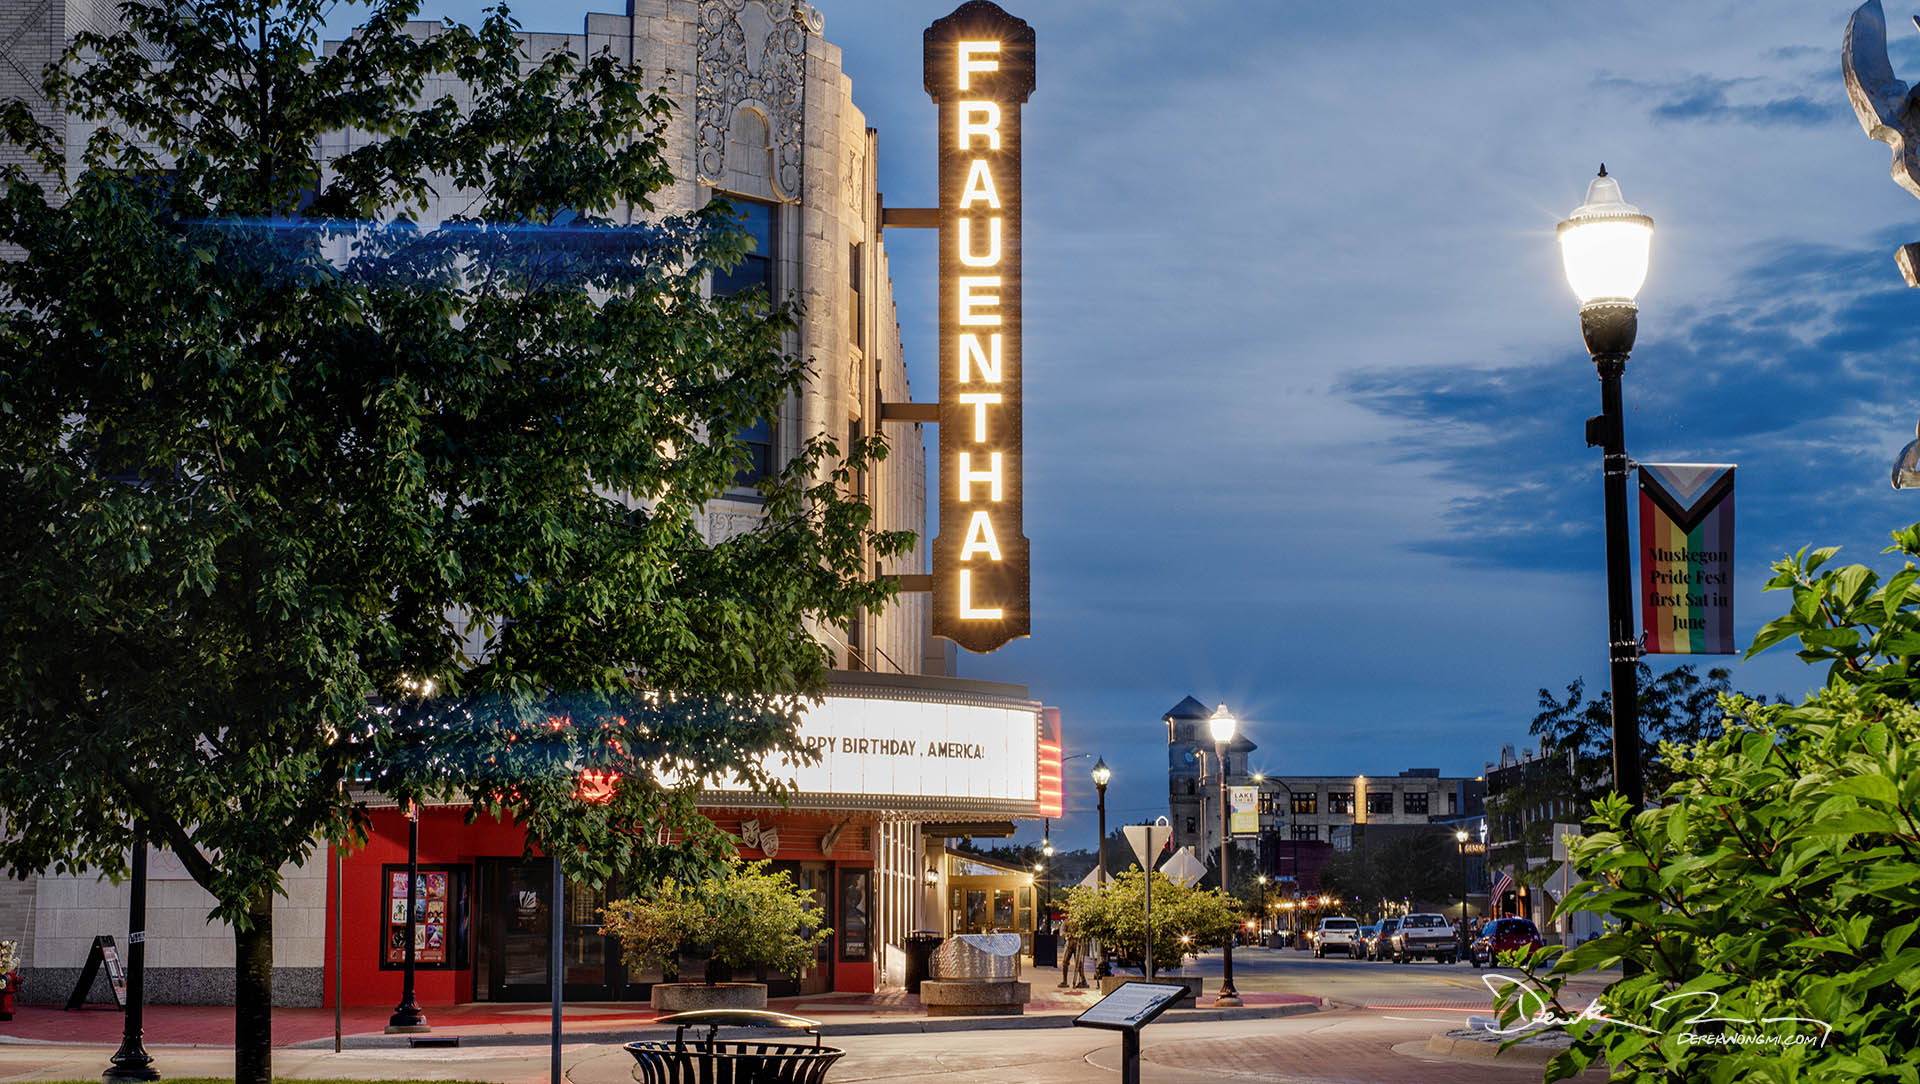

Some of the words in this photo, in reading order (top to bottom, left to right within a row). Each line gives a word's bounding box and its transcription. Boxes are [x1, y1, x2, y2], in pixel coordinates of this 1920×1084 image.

[958, 41, 1002, 619] FRAUENTHAL
[1649, 547, 1728, 565] Muskegon
[1650, 569, 1691, 585] Pride
[1696, 570, 1728, 585] Fest
[1649, 591, 1681, 607] first
[1685, 593, 1708, 607] Sat
[1713, 592, 1728, 607] in
[1673, 615, 1705, 632] June
[927, 741, 985, 760] AMERICA!
